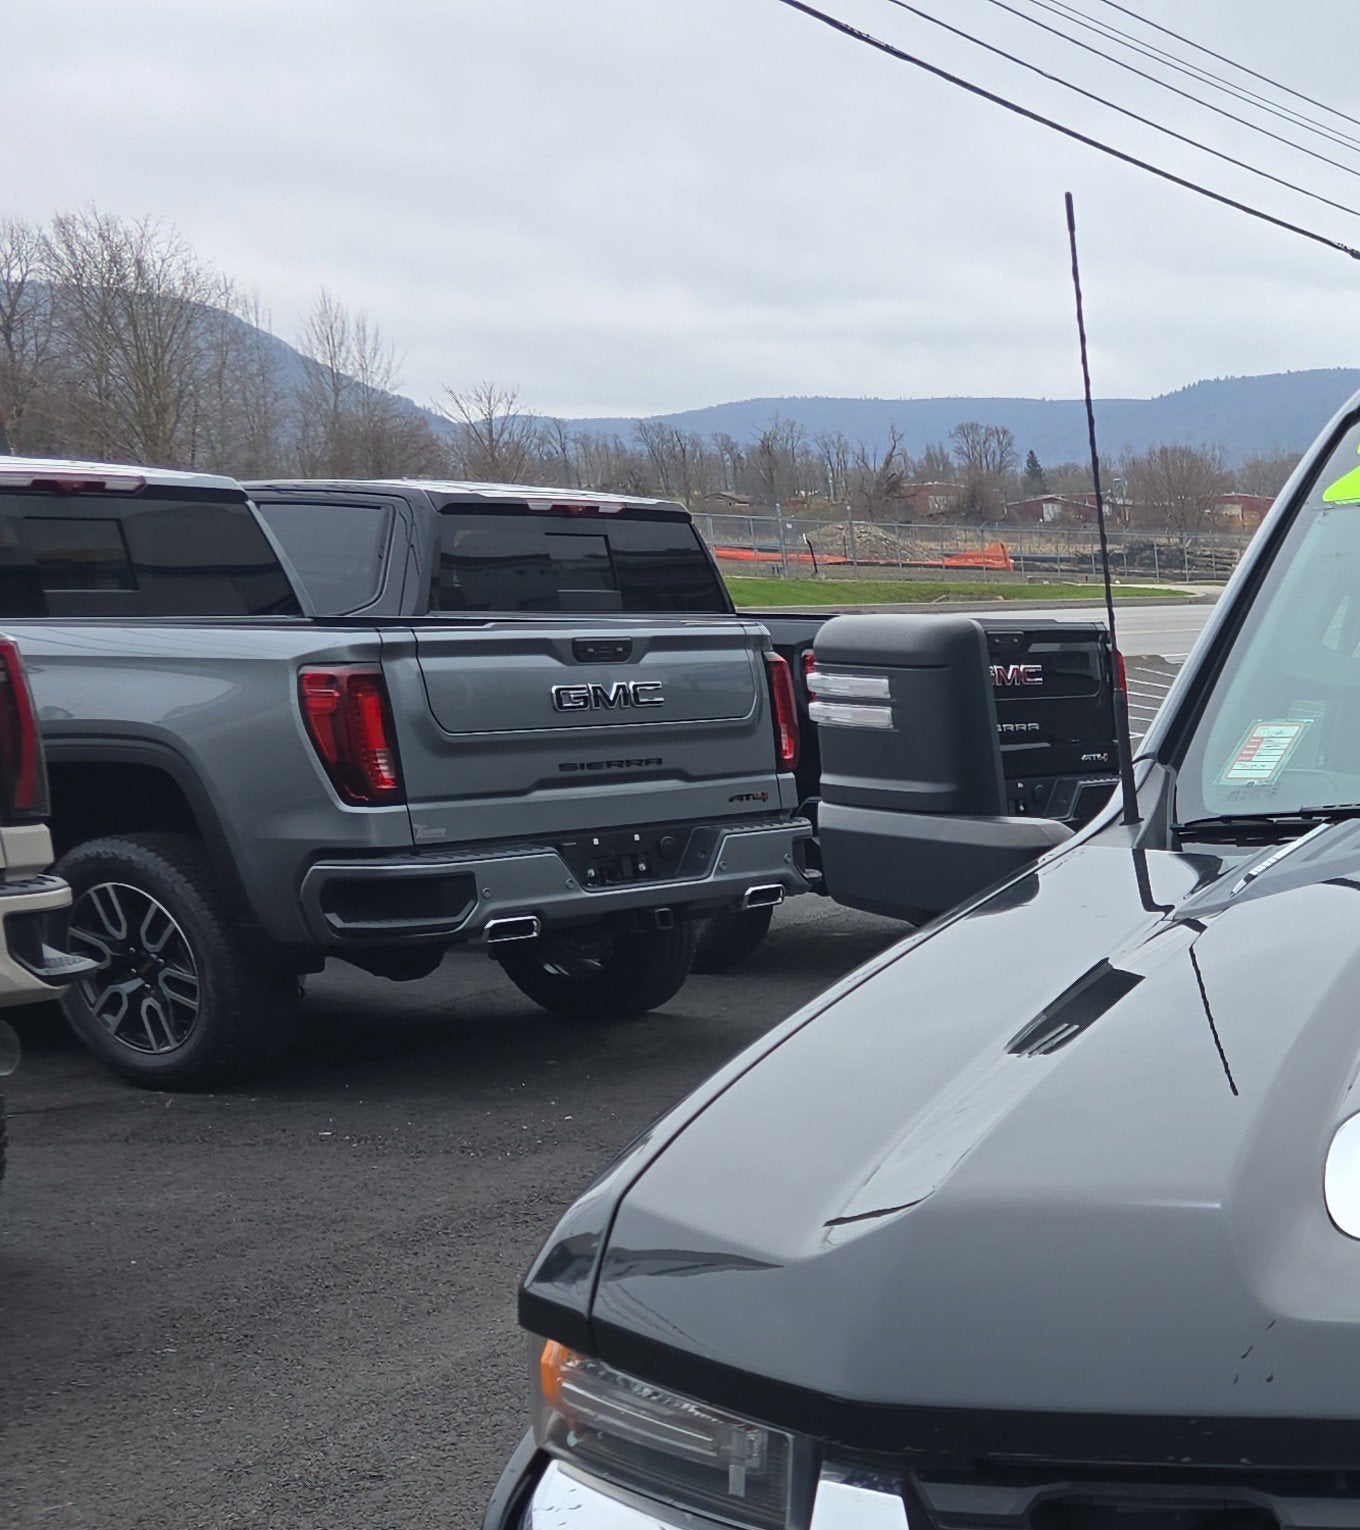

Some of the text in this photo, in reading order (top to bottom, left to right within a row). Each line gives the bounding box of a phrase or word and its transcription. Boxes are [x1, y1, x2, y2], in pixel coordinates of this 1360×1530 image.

[989, 664, 1043, 686] MC
[551, 680, 665, 713] GMC
[996, 722, 1039, 732] RRA
[558, 757, 663, 772] SIERRA
[728, 791, 770, 804] AT4
